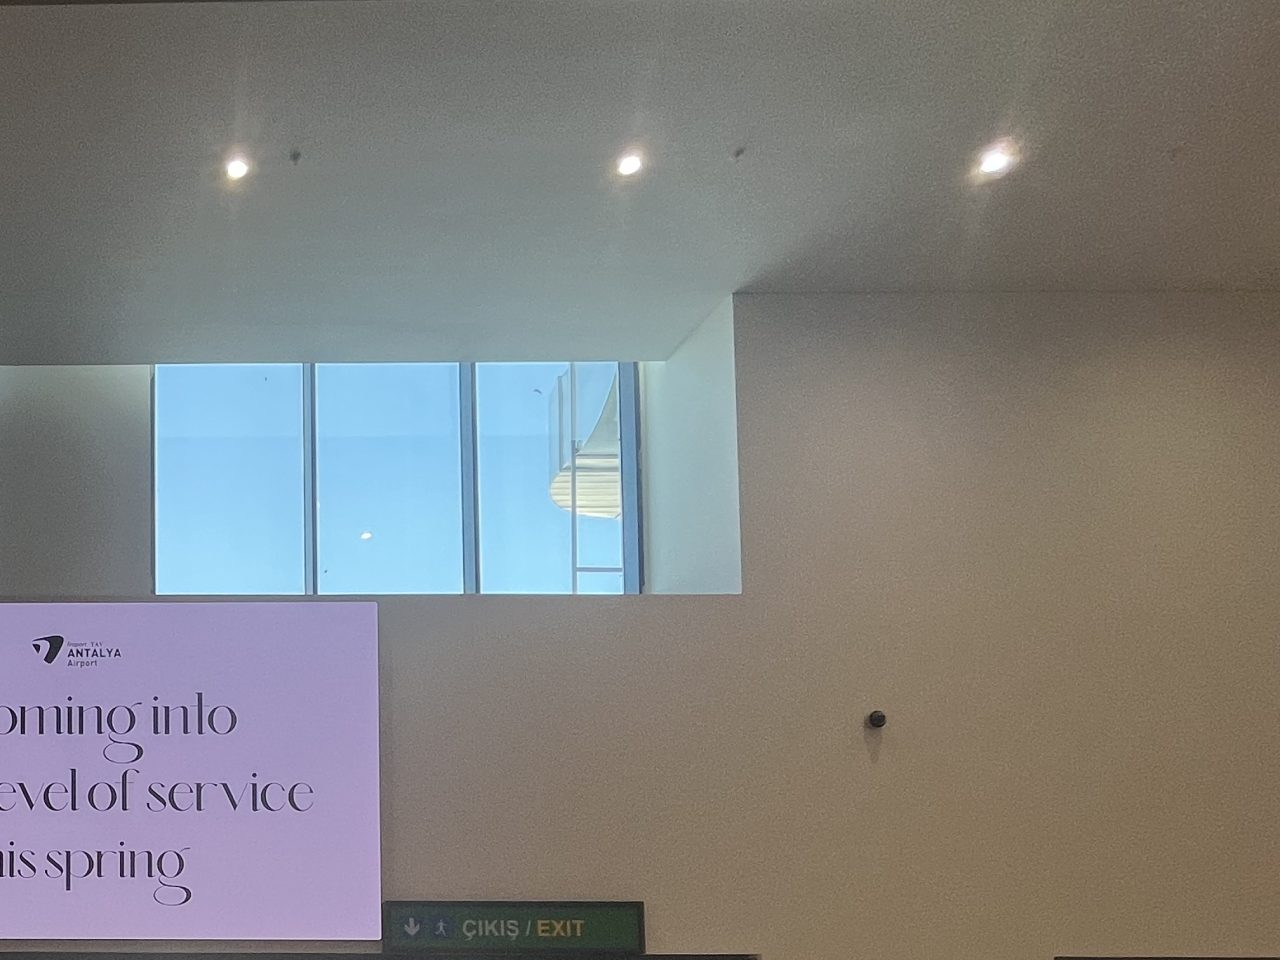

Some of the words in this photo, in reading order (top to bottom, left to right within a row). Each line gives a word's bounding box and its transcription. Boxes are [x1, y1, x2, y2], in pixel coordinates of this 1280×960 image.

[67, 648, 122, 658] ANTALYA
[67, 659, 98, 668] Airport
[151, 691, 238, 736] into
[87, 768, 141, 812] of
[145, 771, 315, 813] service
[45, 840, 192, 907] spring
[462, 919, 519, 940] ÇIKIŞ
[536, 919, 585, 936] EXIT
